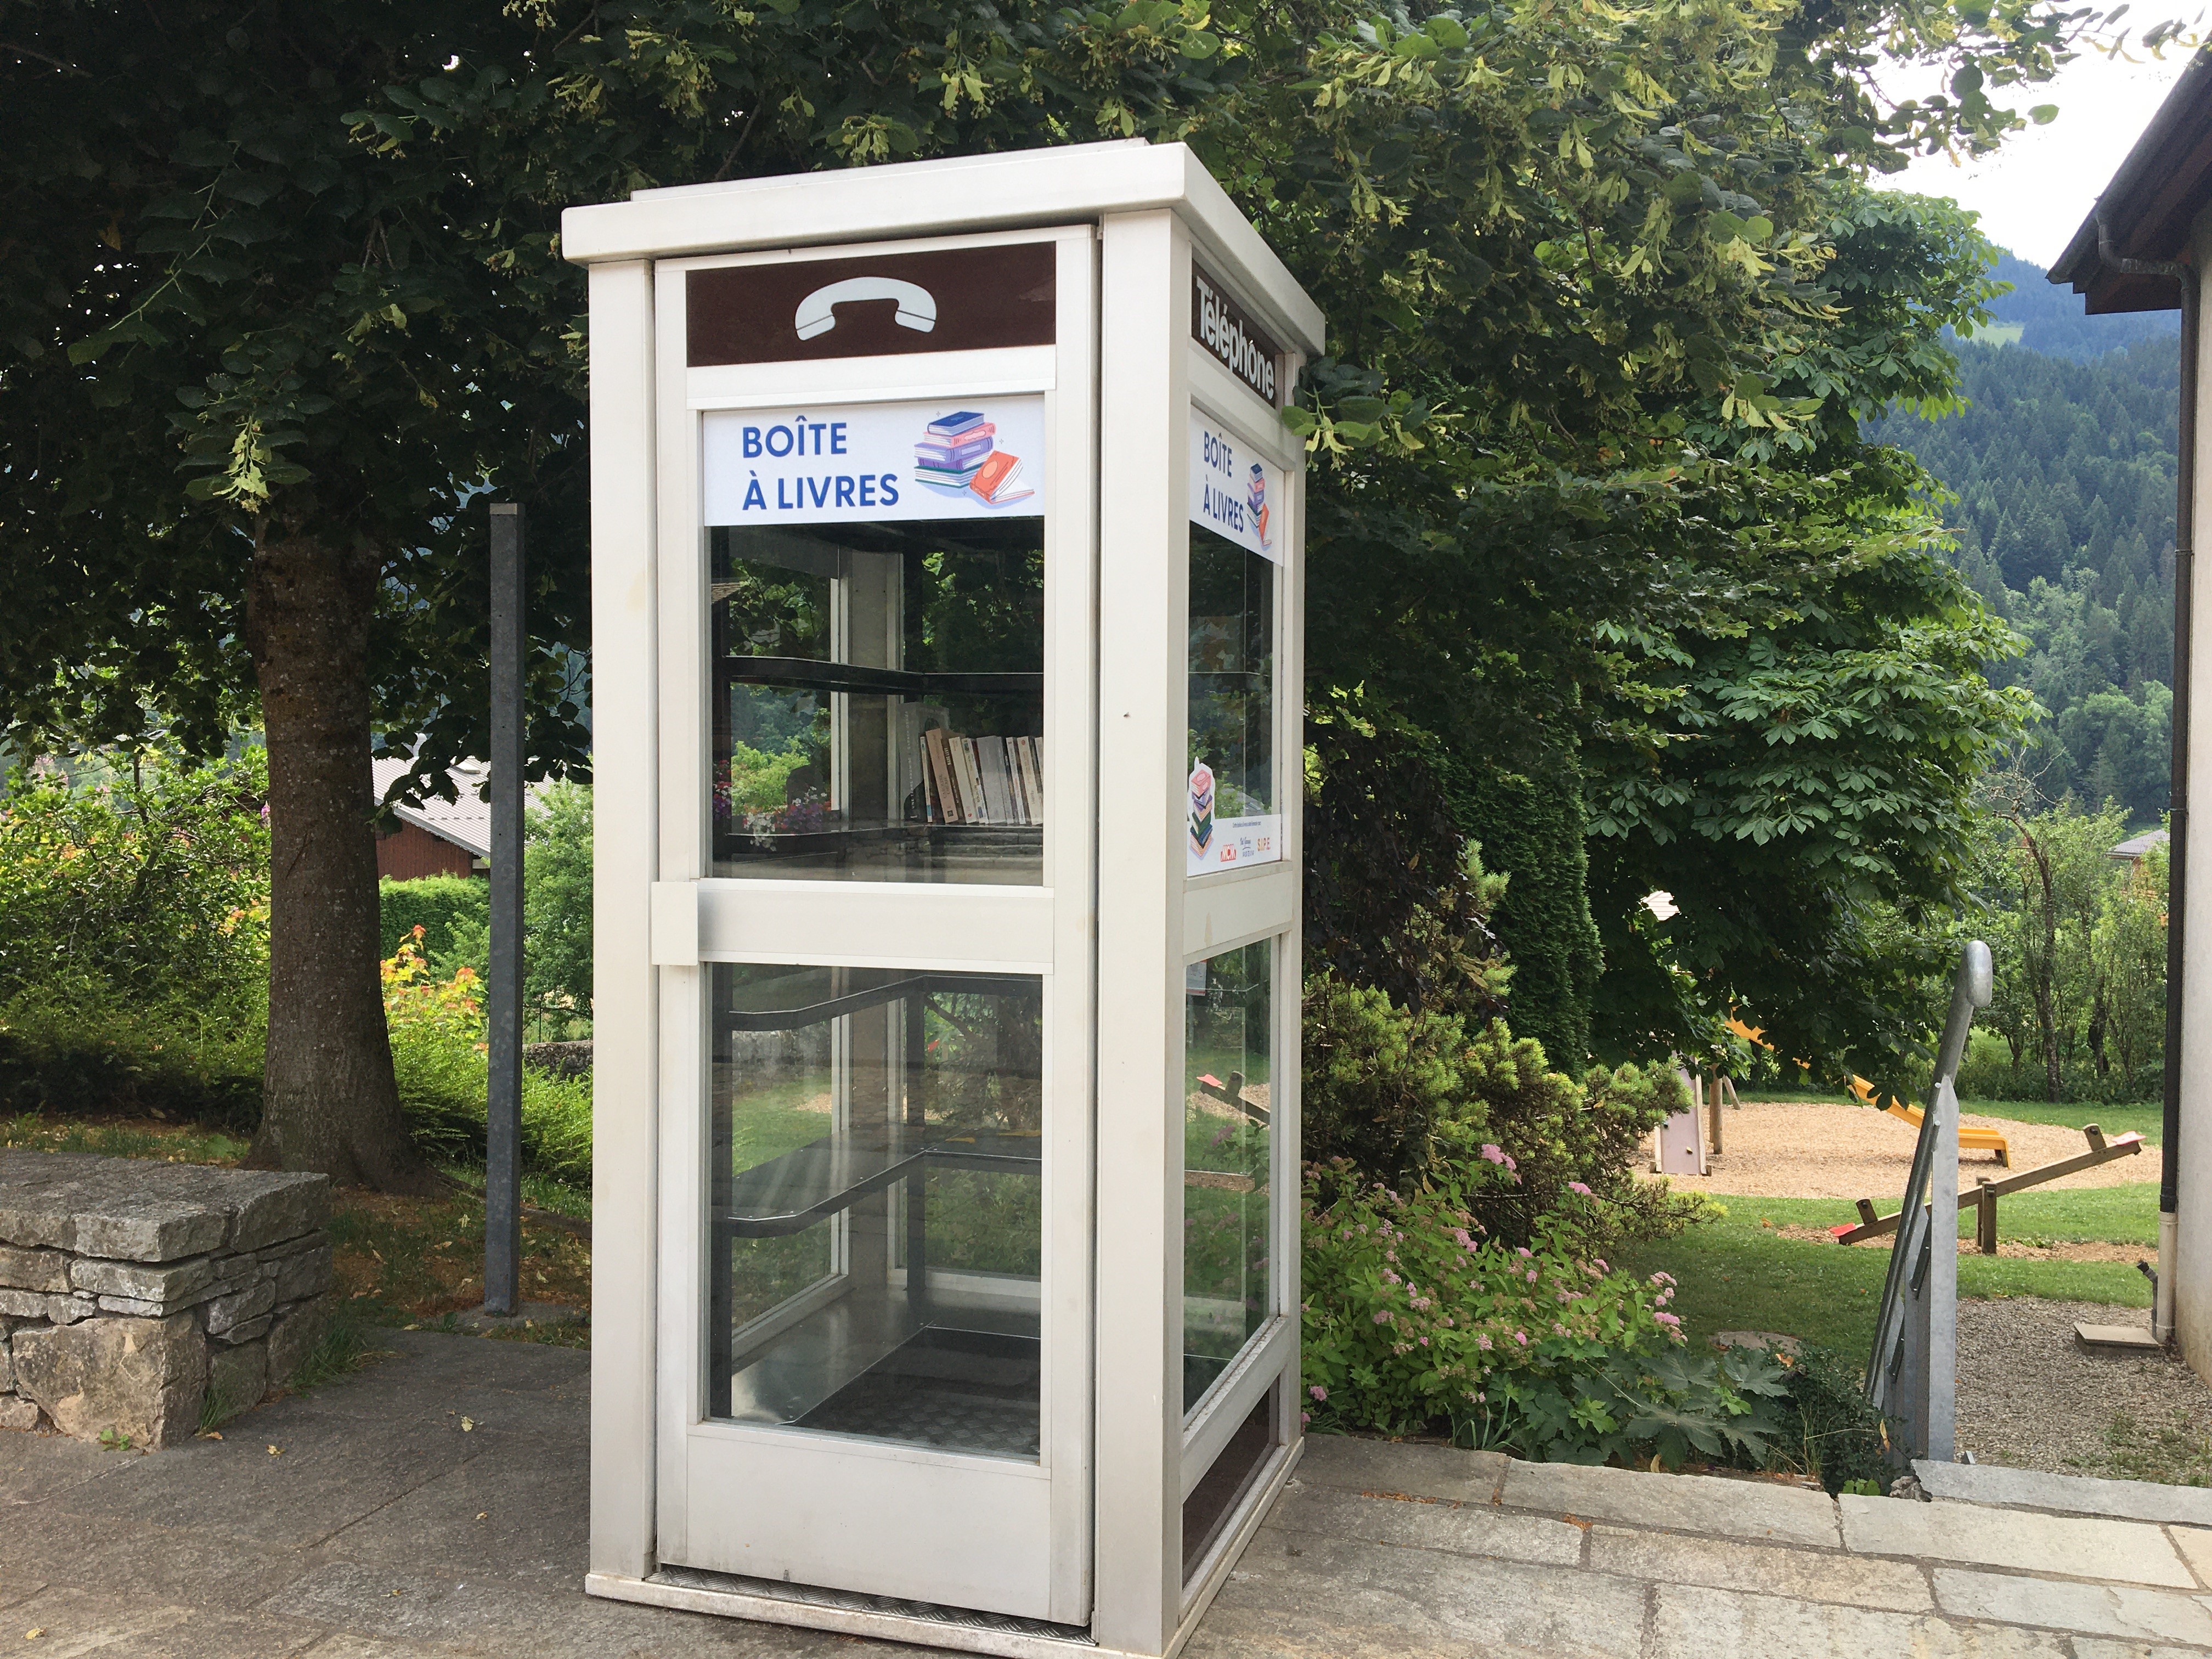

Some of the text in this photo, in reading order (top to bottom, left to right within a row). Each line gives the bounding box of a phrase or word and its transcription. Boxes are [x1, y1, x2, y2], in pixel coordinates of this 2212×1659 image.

[1197, 275, 1274, 400] Téléphone
[742, 415, 847, 459] BOÎTE
[1204, 431, 1232, 478] BOÎTE
[742, 470, 899, 511] À LIVRES
[1203, 474, 1244, 533] À LIVRES
